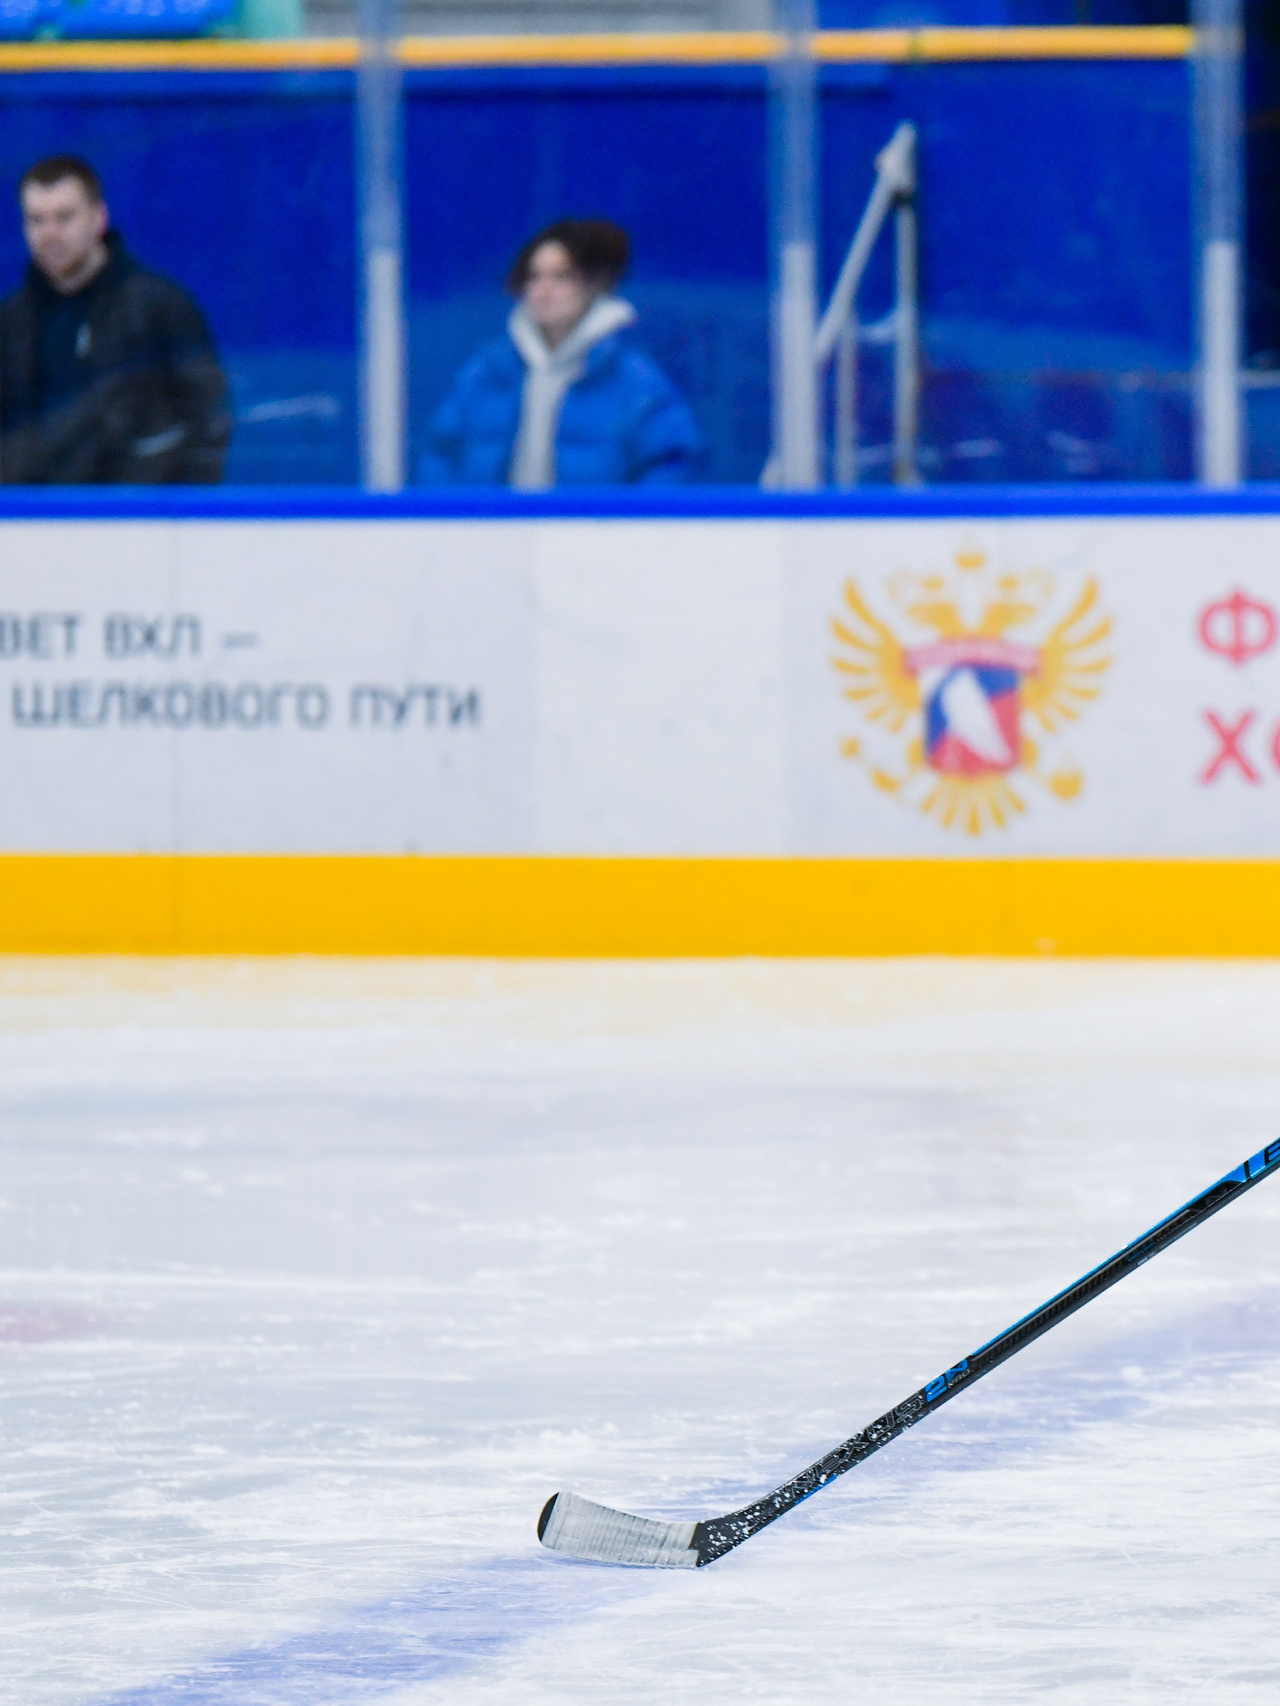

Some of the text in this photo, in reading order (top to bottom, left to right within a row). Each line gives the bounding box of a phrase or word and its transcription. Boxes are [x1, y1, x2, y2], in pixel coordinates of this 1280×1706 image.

[103, 612, 202, 660] ВХЛ
[12, 681, 482, 729] ШЕЛКОВОГО ПУТИ
